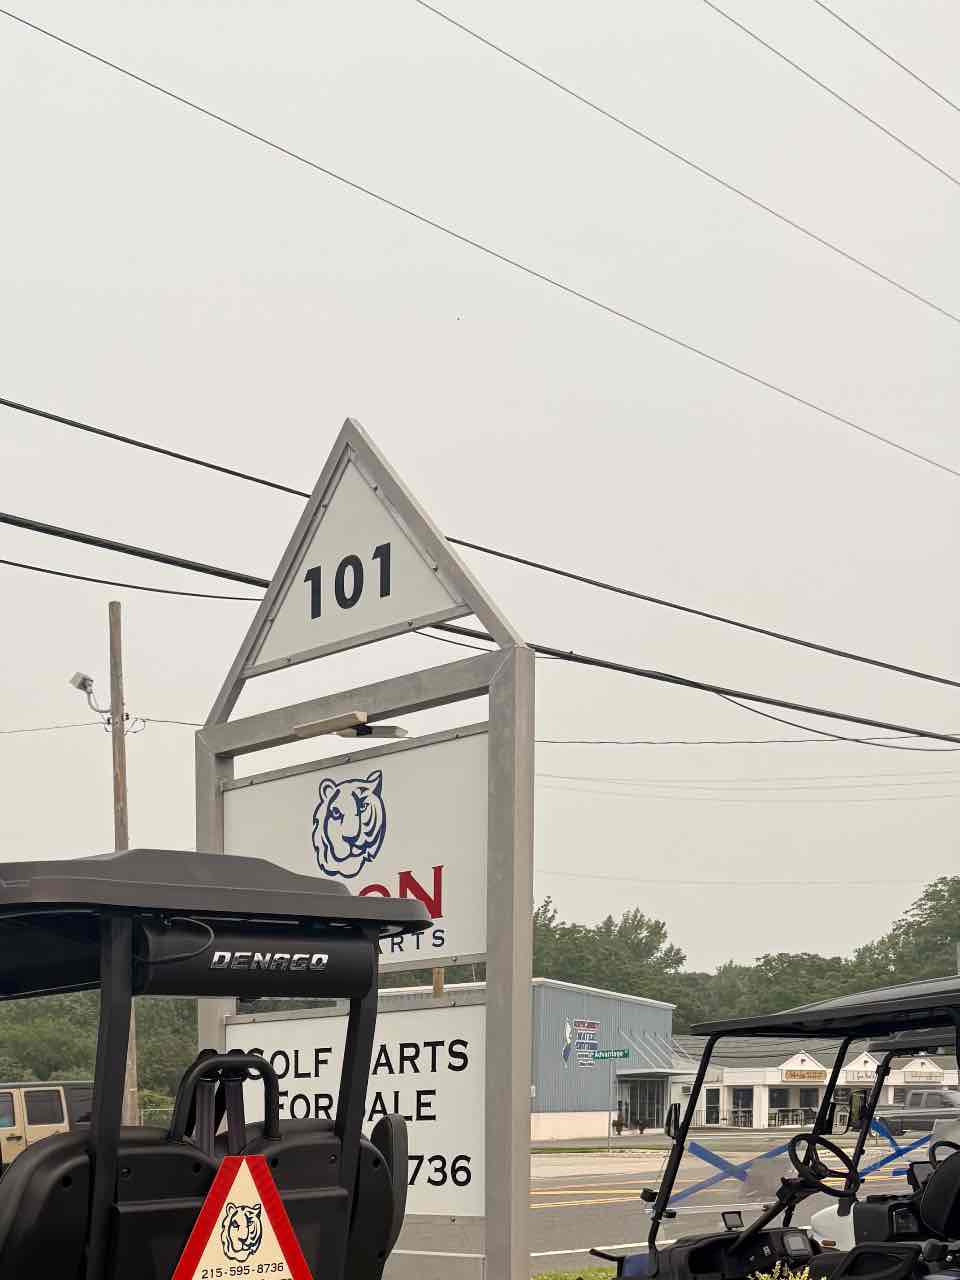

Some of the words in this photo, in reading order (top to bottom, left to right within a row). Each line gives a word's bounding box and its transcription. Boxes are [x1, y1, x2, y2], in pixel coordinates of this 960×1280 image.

[303, 542, 391, 620] 101
[378, 929, 445, 954] RTS
[210, 951, 329, 971] DENAGO
[371, 1039, 470, 1075] ARTS
[367, 1089, 437, 1122] ALE
[201, 1262, 284, 1279] 215-595-8736
